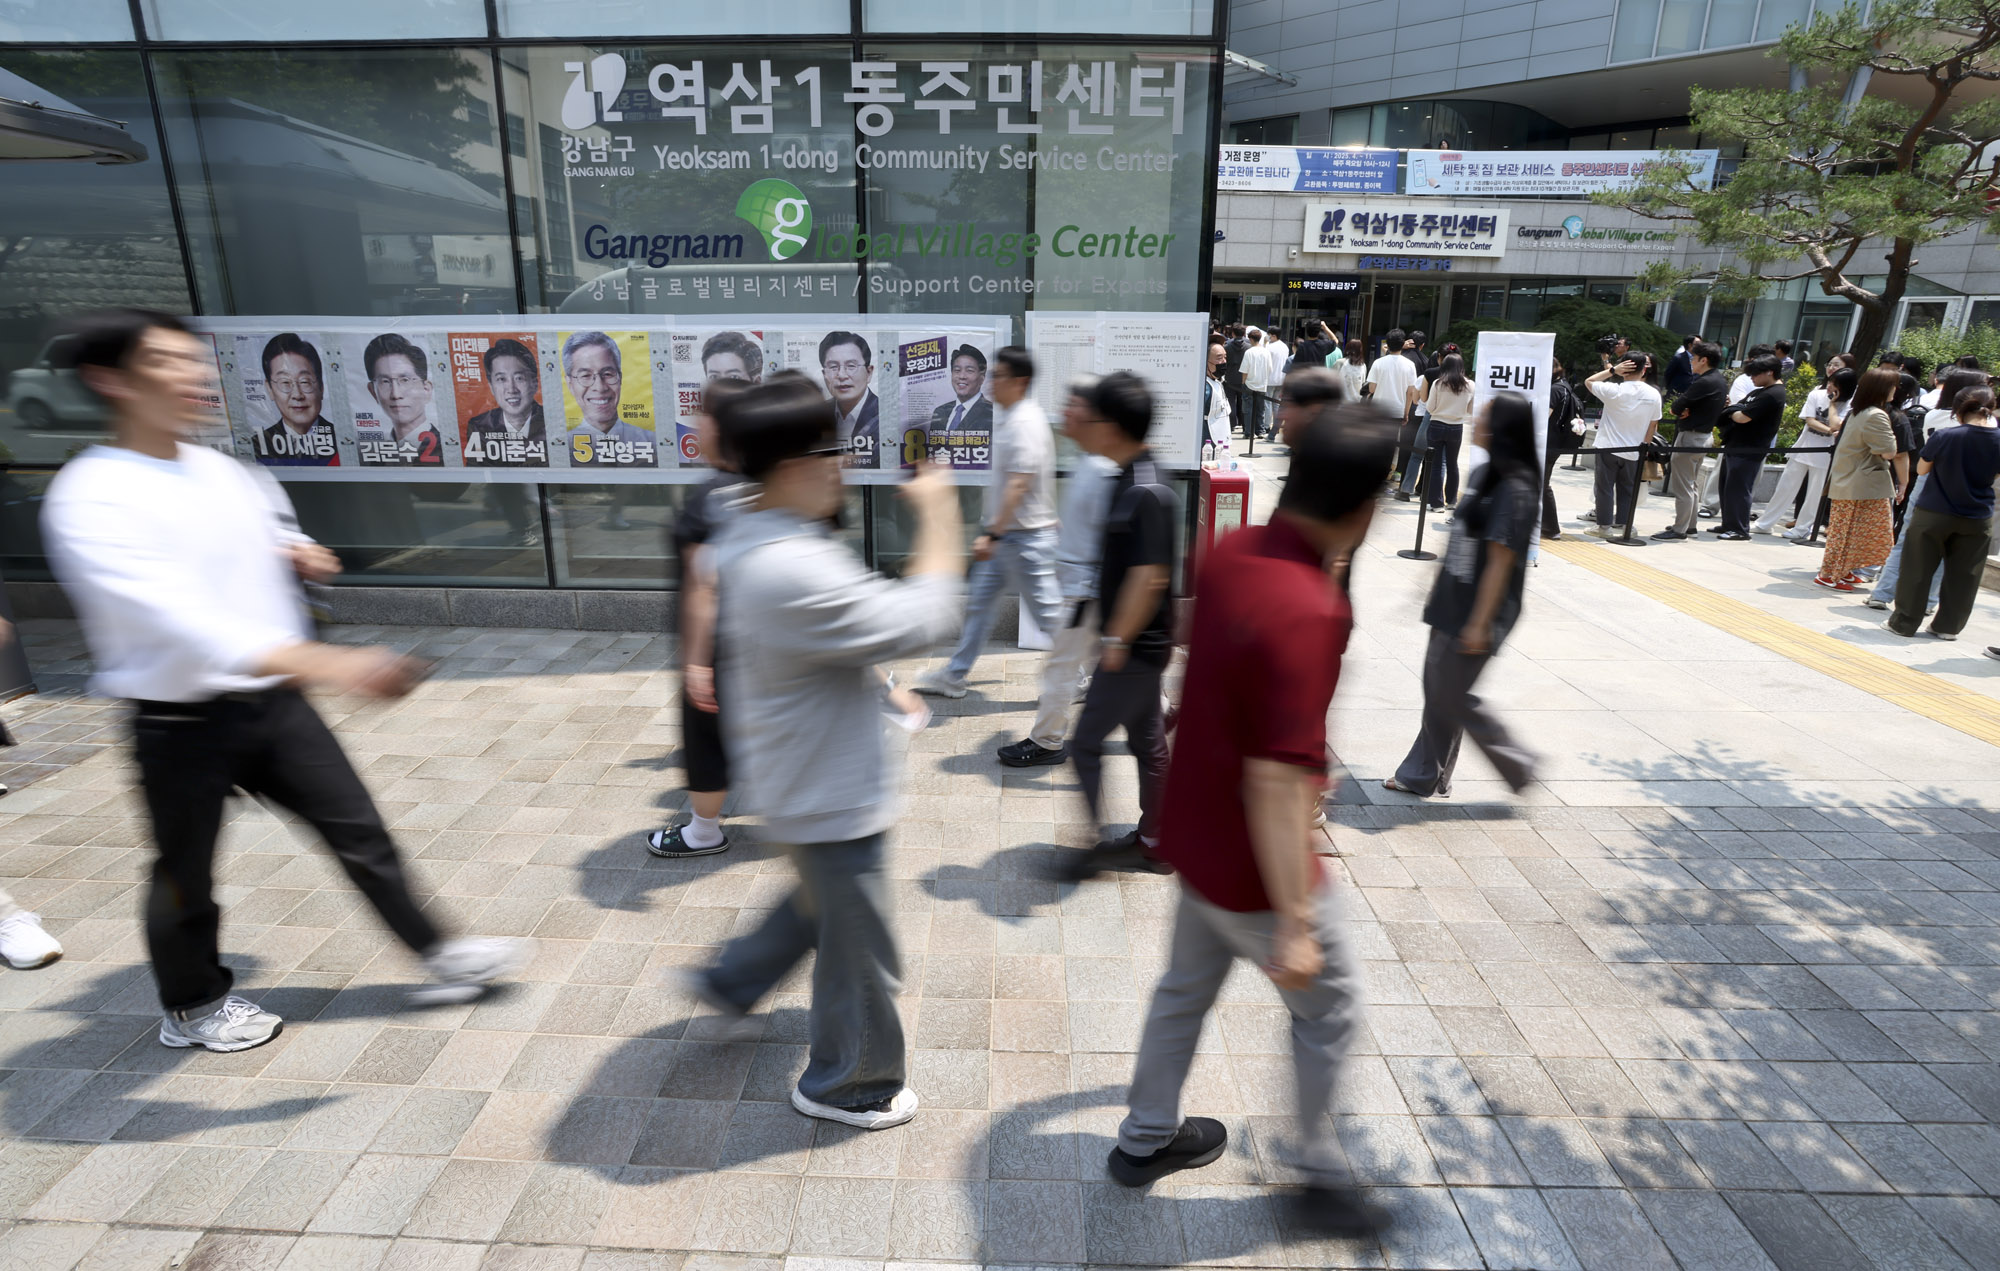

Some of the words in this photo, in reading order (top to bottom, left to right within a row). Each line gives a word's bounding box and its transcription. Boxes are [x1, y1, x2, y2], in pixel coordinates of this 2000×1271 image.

[648, 59, 1185, 136] 역삼1동주민센터
[560, 136, 636, 163] 강남구
[653, 145, 751, 170] Yeoksam
[760, 144, 839, 173] 1-dong
[856, 143, 990, 174] Community
[999, 144, 1088, 170] Service
[1097, 147, 1179, 172] Center
[1225, 151, 1241, 162] 거점
[620, 166, 635, 176] GU
[1228, 166, 1254, 177] 교환해
[1256, 167, 1290, 178] 드립니다
[1441, 163, 1466, 176] 세탁
[1467, 163, 1479, 176] 및
[1482, 163, 1493, 176] 짐
[1496, 163, 1519, 176] 보관
[1521, 164, 1556, 176] 서비스
[1351, 211, 1497, 238] 역삼1동주민센터
[1319, 234, 1344, 244] 강남구
[1518, 226, 1562, 239] Gangnam
[1608, 229, 1642, 243] Village
[585, 224, 744, 269] Gangnam
[914, 223, 1042, 268] Village
[1052, 224, 1177, 258] Center
[1350, 238, 1378, 248] Yeoksam
[1381, 239, 1403, 250] 1-dong
[1406, 240, 1443, 251] Community
[1444, 241, 1468, 250] Service
[1470, 242, 1492, 251] Center
[871, 274, 960, 296] Support
[969, 275, 1043, 294] Center
[1053, 276, 1081, 293] for
[1092, 277, 1169, 297] Expats
[1288, 281, 1302, 289] 365
[1303, 281, 1357, 291] 무인민원발급창구
[452, 338, 490, 352] 미래를
[906, 340, 941, 359] 선경제,
[453, 353, 480, 367] 여는
[906, 354, 941, 373] 후정치!
[456, 367, 482, 382] 선택
[1489, 365, 1536, 390] 관내
[678, 391, 702, 403] 정치
[312, 426, 332, 434] 지금은
[272, 434, 336, 456] 이재명
[359, 441, 418, 462] 김문수
[418, 431, 440, 462] 2
[464, 431, 486, 462] 4
[486, 440, 546, 462] 이준석
[572, 434, 594, 463] 5
[595, 441, 654, 463] 권영국
[680, 433, 702, 460] 6
[904, 429, 927, 464] 8
[934, 446, 990, 464] 송진호
[965, 436, 990, 445] 해결사
